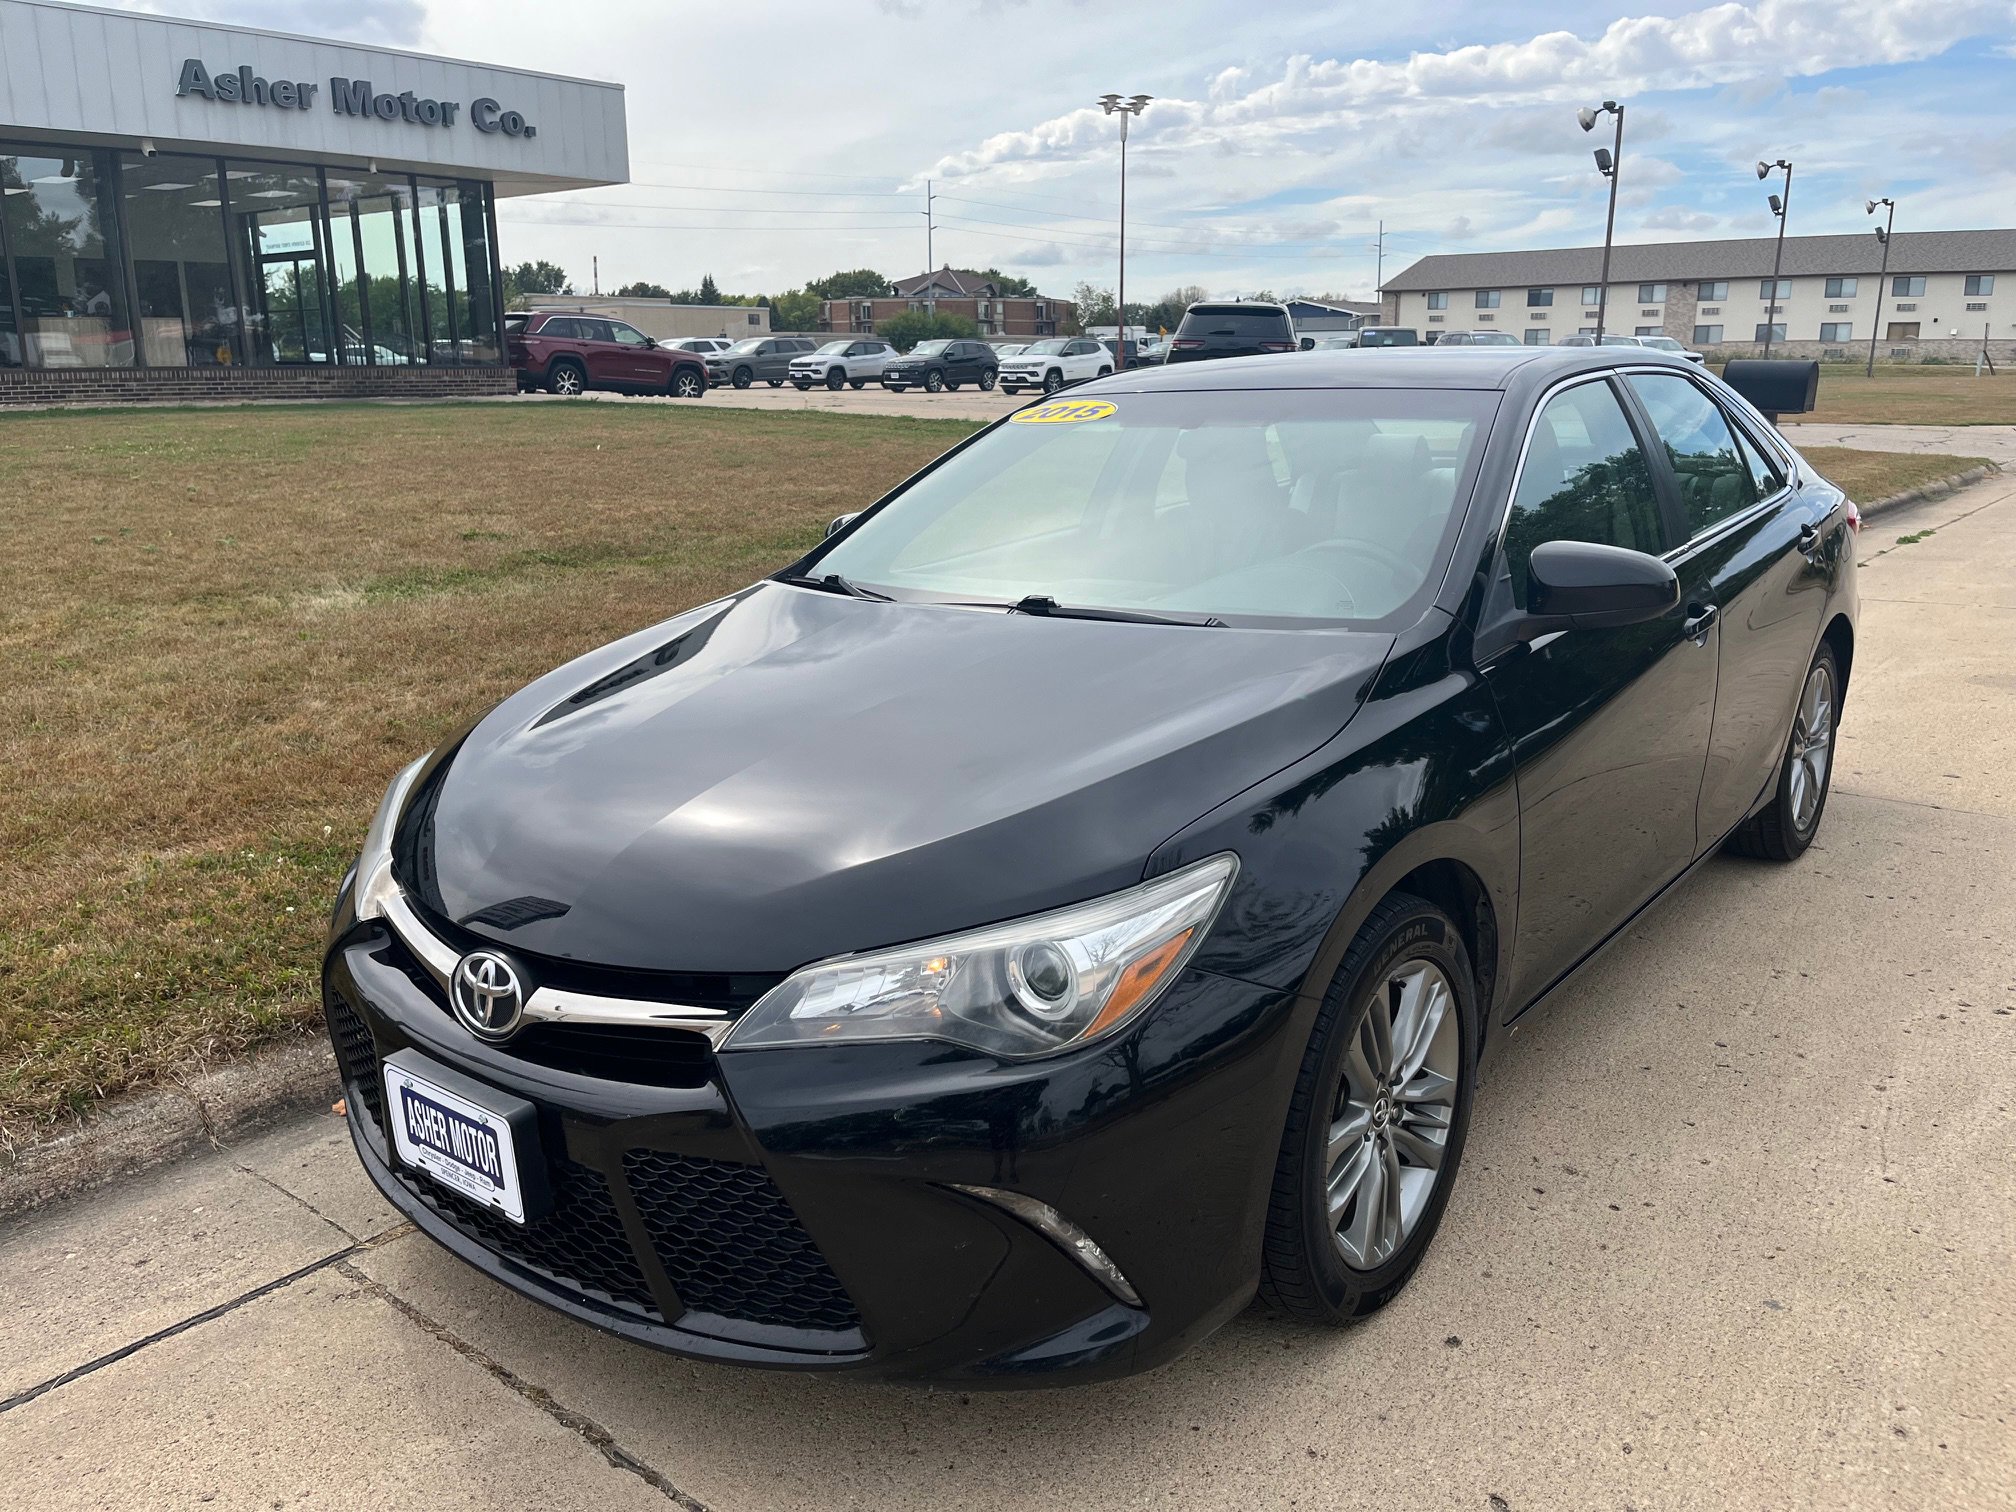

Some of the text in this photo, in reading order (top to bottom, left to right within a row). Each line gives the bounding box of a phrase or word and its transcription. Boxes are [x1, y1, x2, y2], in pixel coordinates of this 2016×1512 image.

[176, 58, 537, 137] Asher Motor Co.
[1020, 405, 1108, 420] 2015
[407, 1096, 500, 1178] ASHER MOTOR
[422, 1147, 442, 1162] Chrysler
[479, 1176, 492, 1187] Ram
